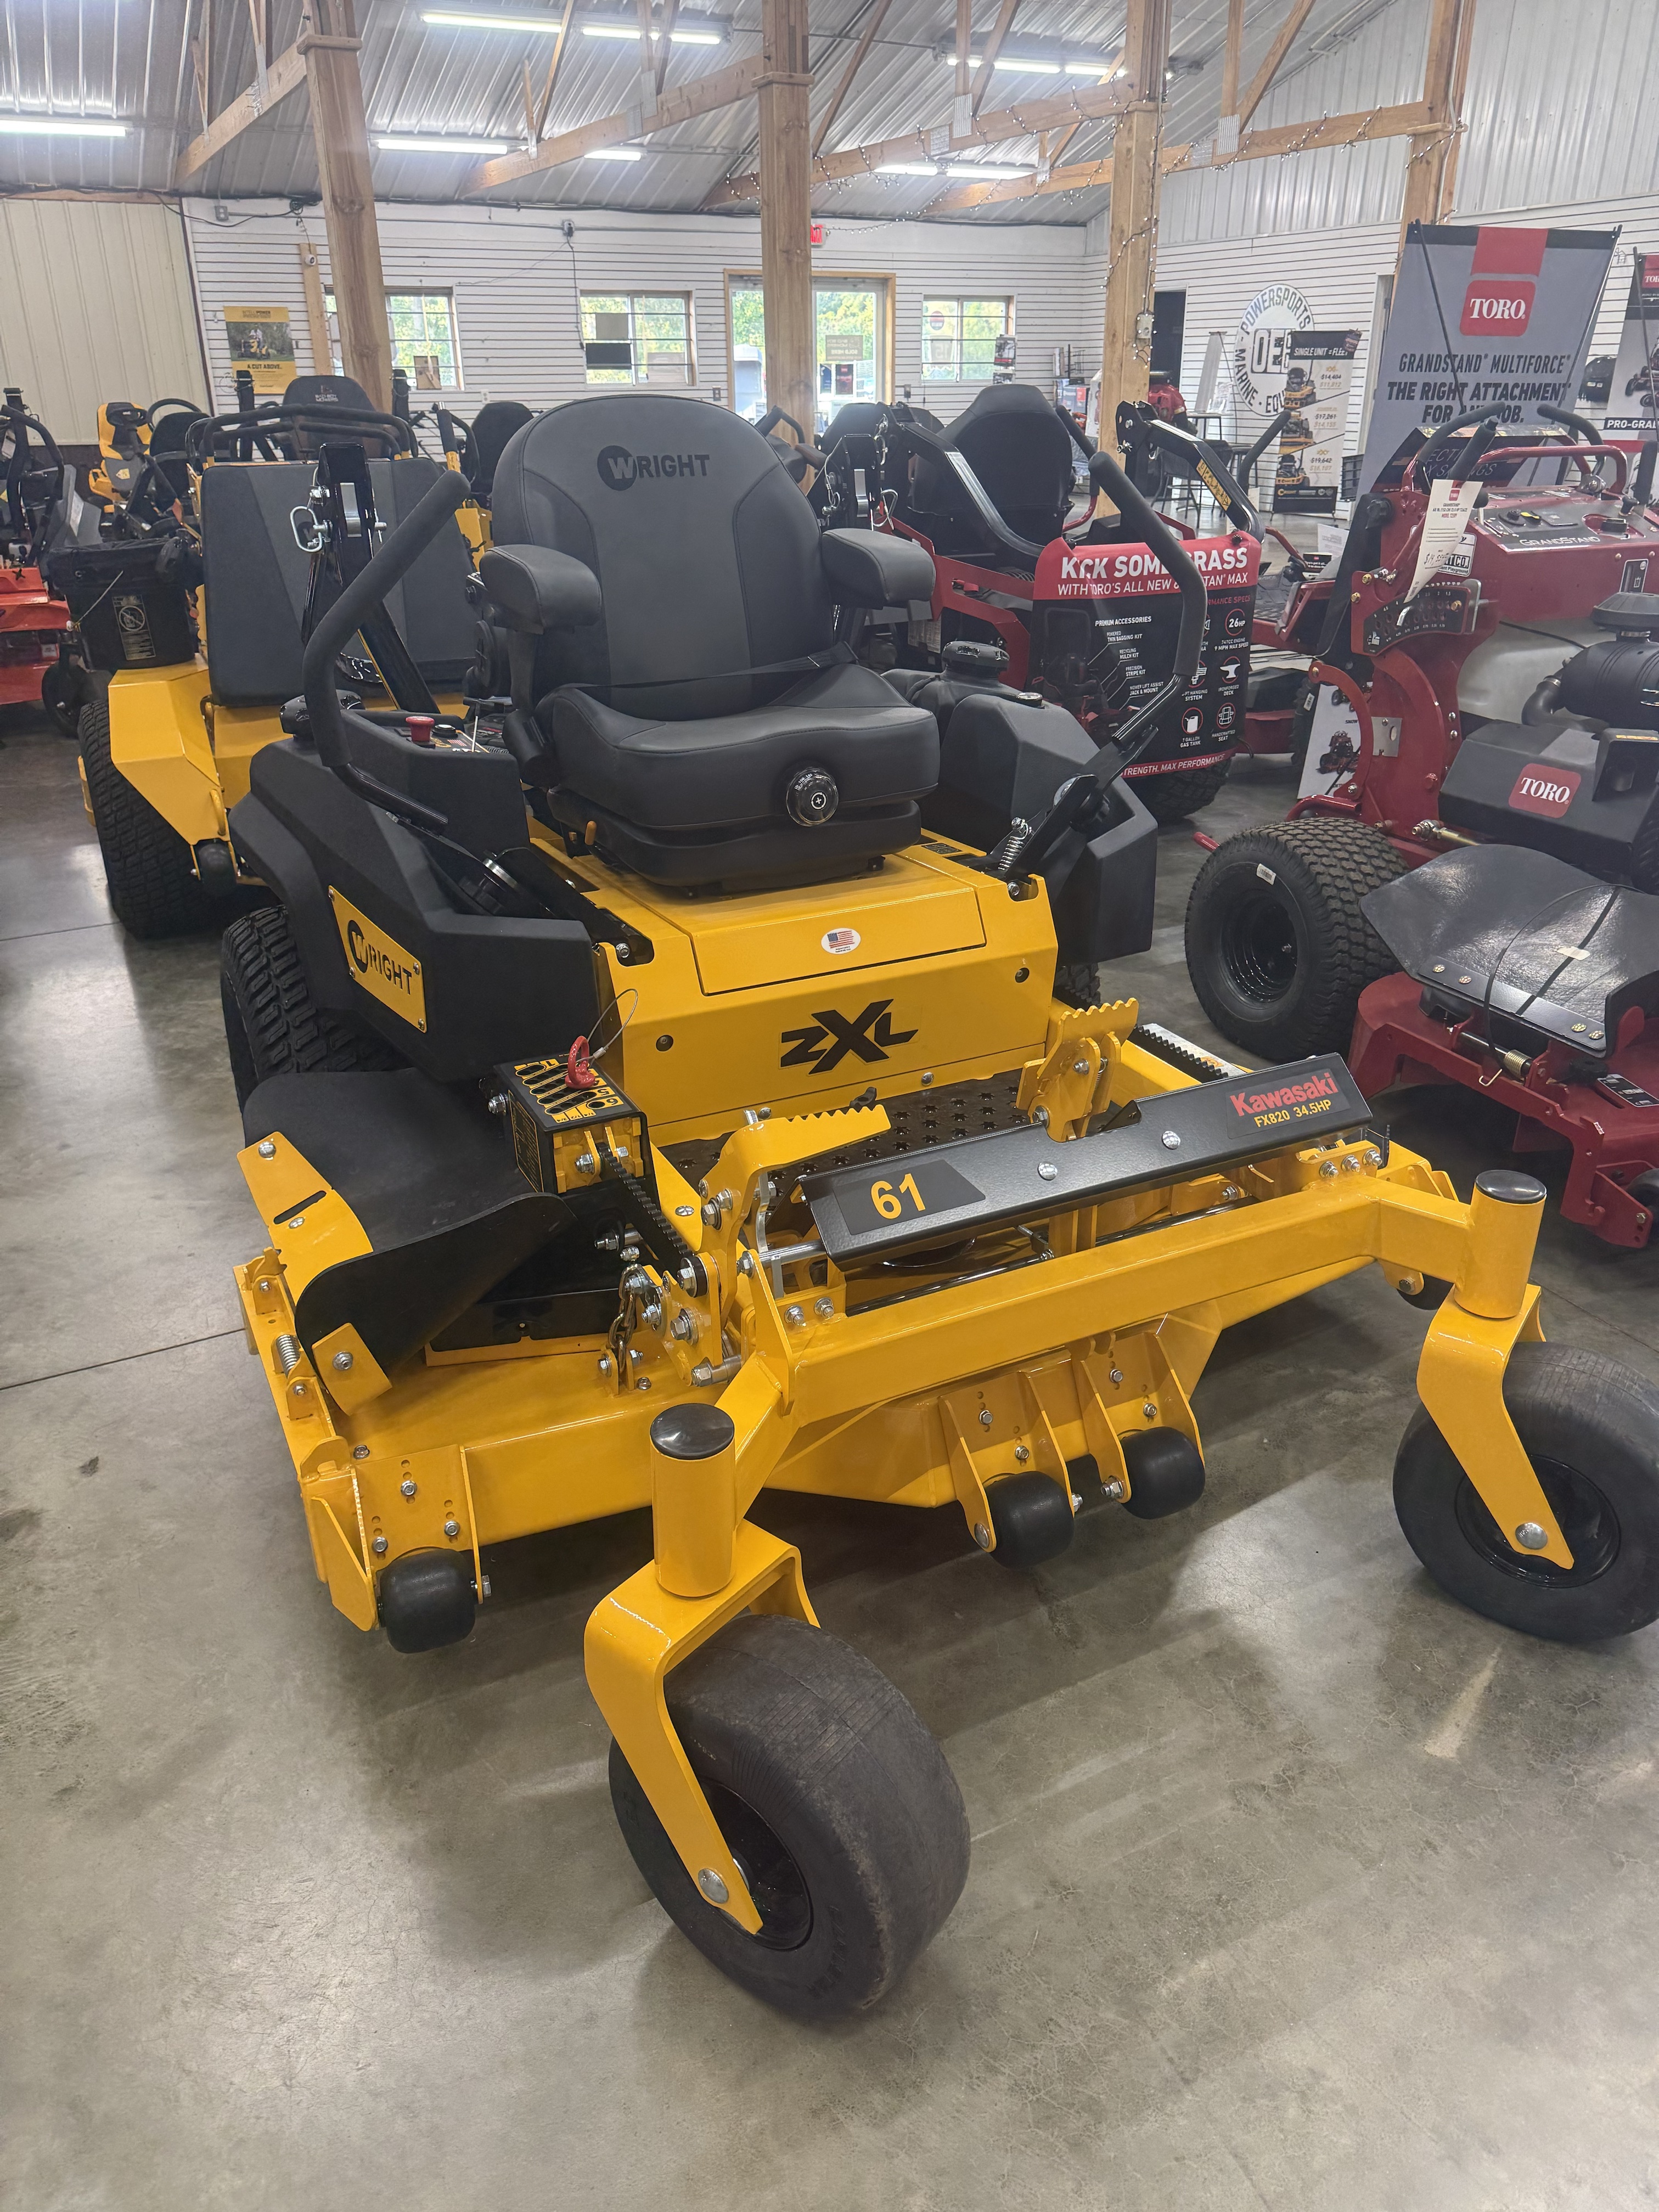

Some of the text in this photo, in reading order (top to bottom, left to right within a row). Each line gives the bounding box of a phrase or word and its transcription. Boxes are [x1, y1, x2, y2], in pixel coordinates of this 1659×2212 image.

[1240, 287, 1311, 335] POWERSPORTS
[1470, 299, 1525, 319] TORO
[1294, 348, 1314, 356] SINGLE
[1314, 348, 1328, 356] UNIT
[1235, 348, 1258, 407] MARINE
[1388, 382, 1571, 401] THE RIGHT ATTACHMENT
[1422, 405, 1454, 424] FOR
[604, 452, 710, 482] WRIGHT
[1456, 556, 1467, 567] CO.
[1058, 584, 1088, 596] WITH
[1123, 581, 1144, 593] ALL
[1147, 579, 1172, 591] NEW
[1229, 572, 1248, 584] MAX
[1115, 616, 1152, 625] ACCESSORIES
[1161, 762, 1177, 772] MAX
[1178, 753, 1225, 769] PERFORMANCE
[1519, 777, 1570, 803] TORO
[350, 925, 412, 995] WRIGHT
[780, 999, 919, 1075] ZXL
[1229, 1072, 1339, 1117] Kawasaki
[1253, 1099, 1331, 1128] FX820 34.5HP
[870, 1173, 926, 1219] 61
